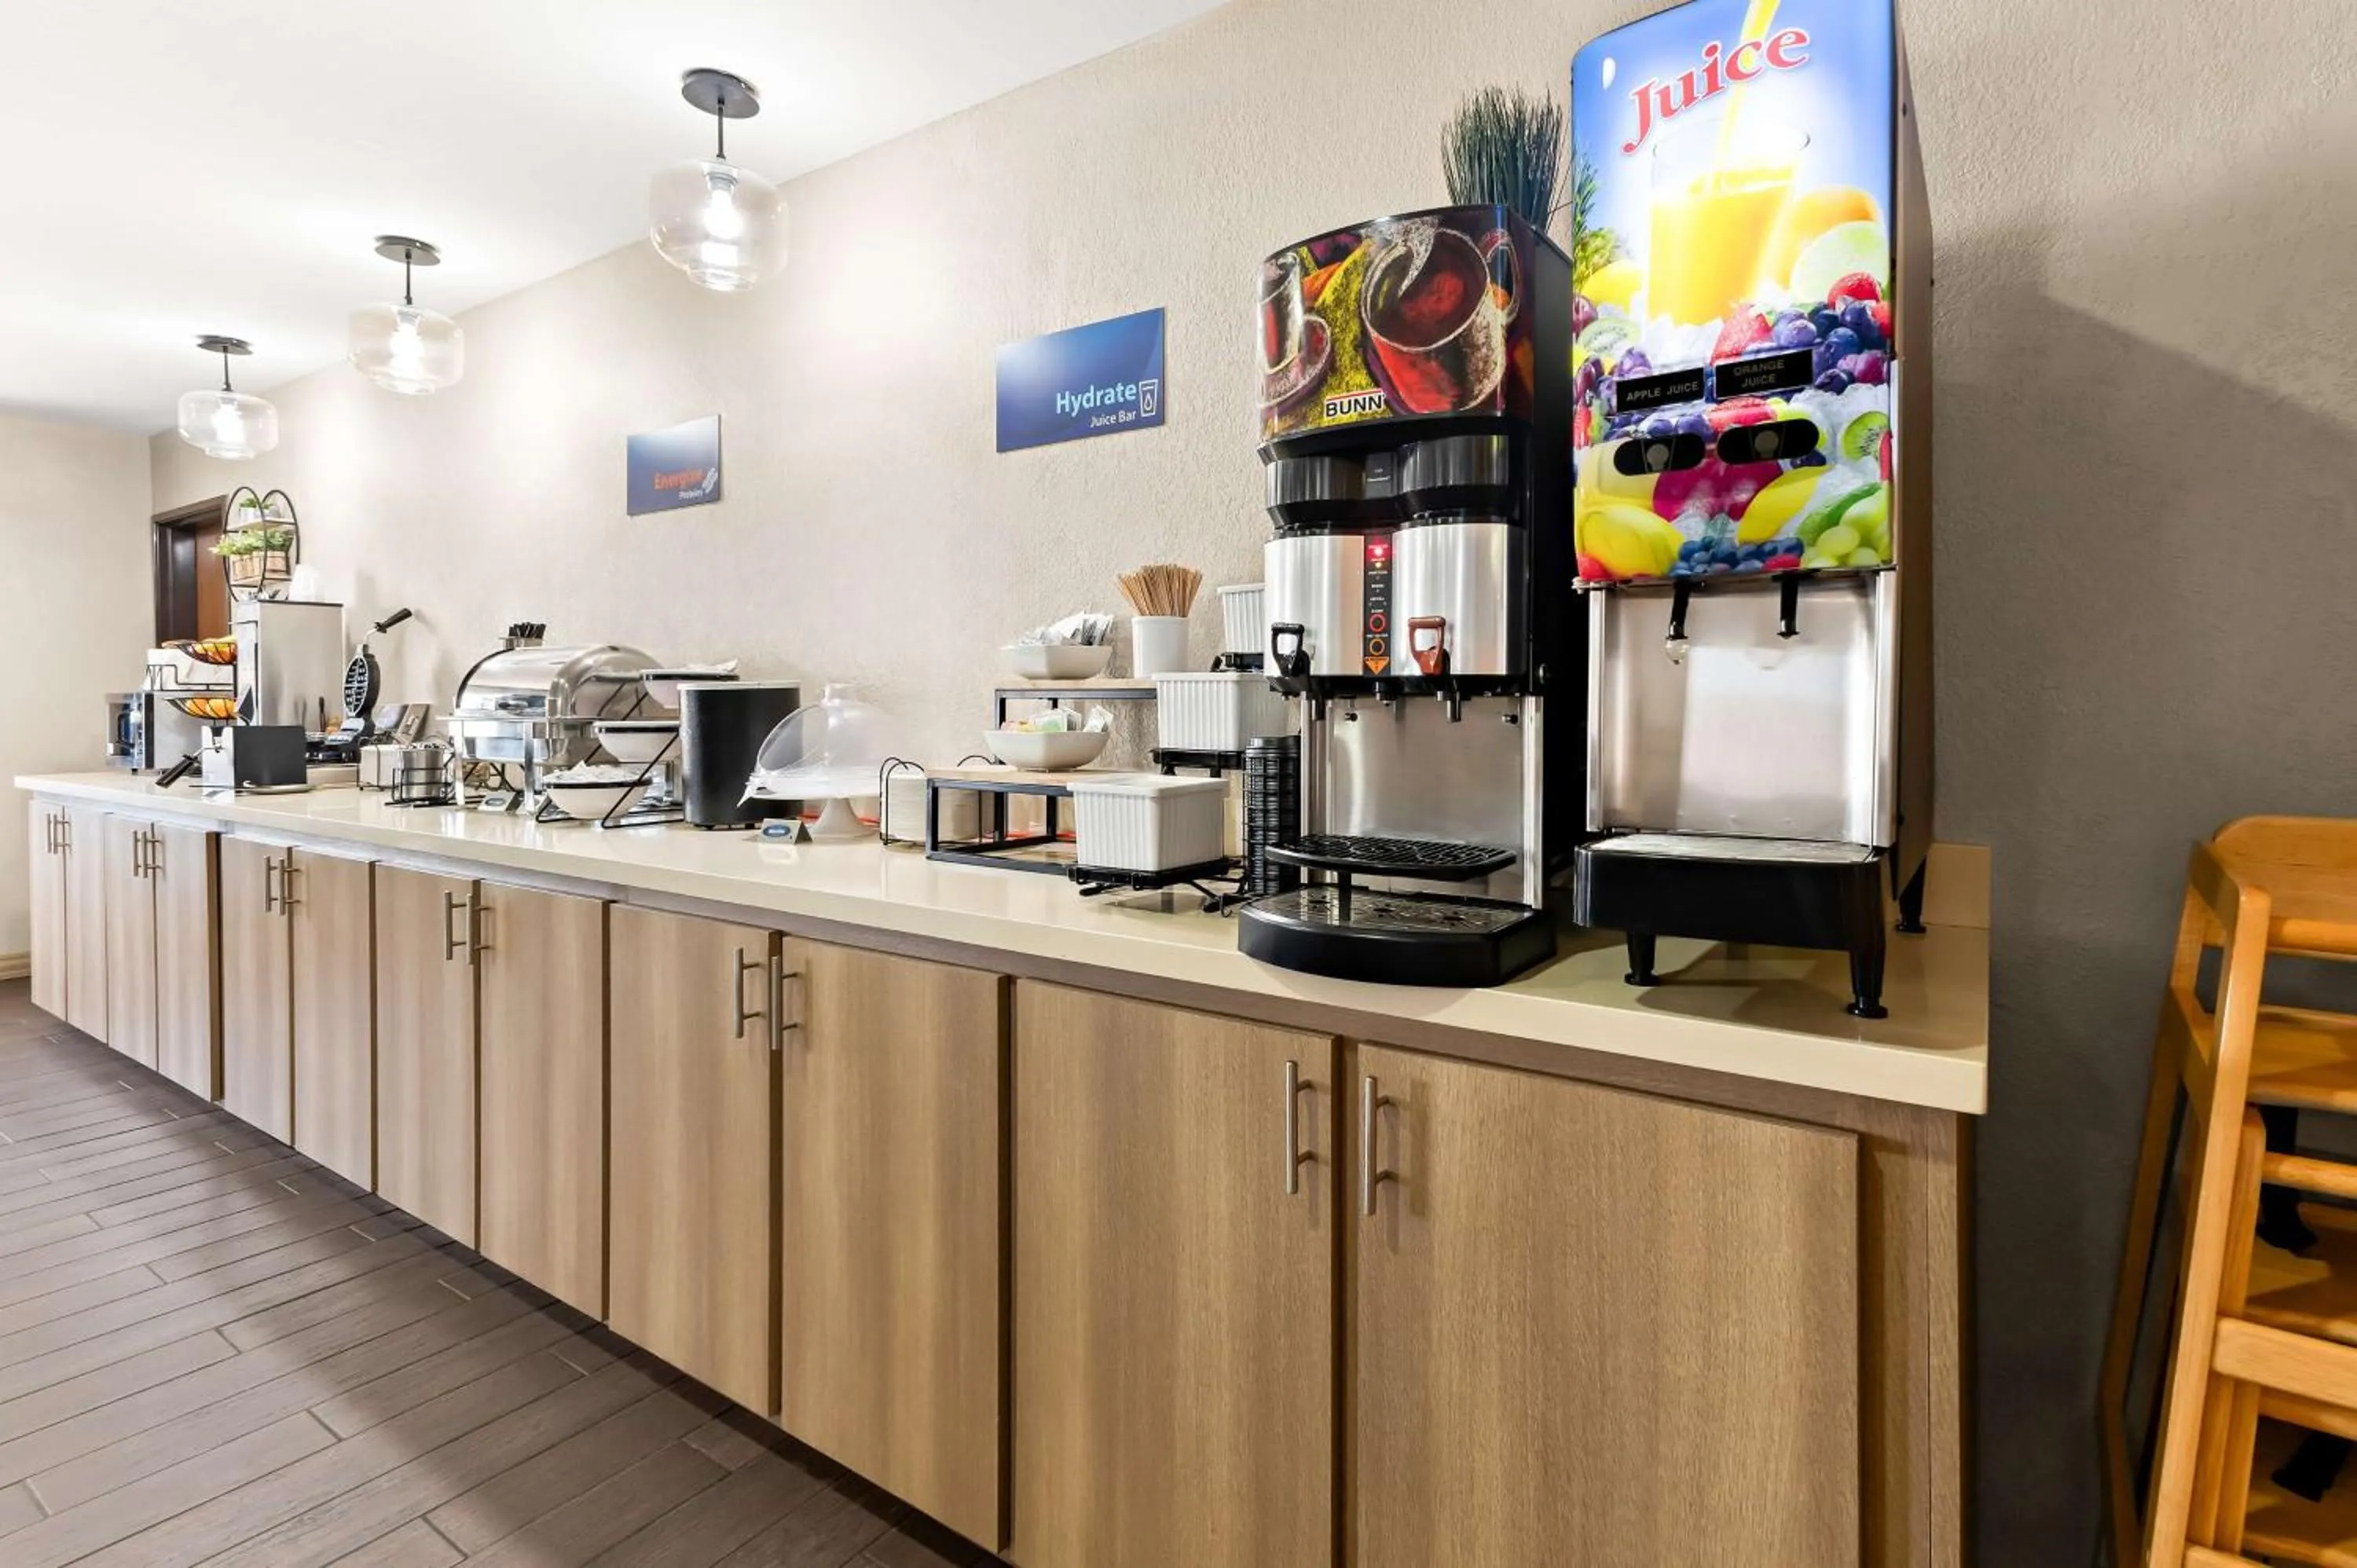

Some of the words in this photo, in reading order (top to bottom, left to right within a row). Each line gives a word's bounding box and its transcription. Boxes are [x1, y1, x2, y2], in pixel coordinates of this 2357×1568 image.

[1622, 28, 1809, 154] Juice
[1733, 359, 1785, 376] ORANGE
[1741, 373, 1776, 388] JUICE
[1056, 383, 1136, 417] Hydrate
[1626, 387, 1661, 401] APPLE
[1666, 381, 1699, 395] JUICE
[1326, 395, 1382, 417] BUNN
[1090, 413, 1117, 428] Juice
[1118, 409, 1137, 423] Bar
